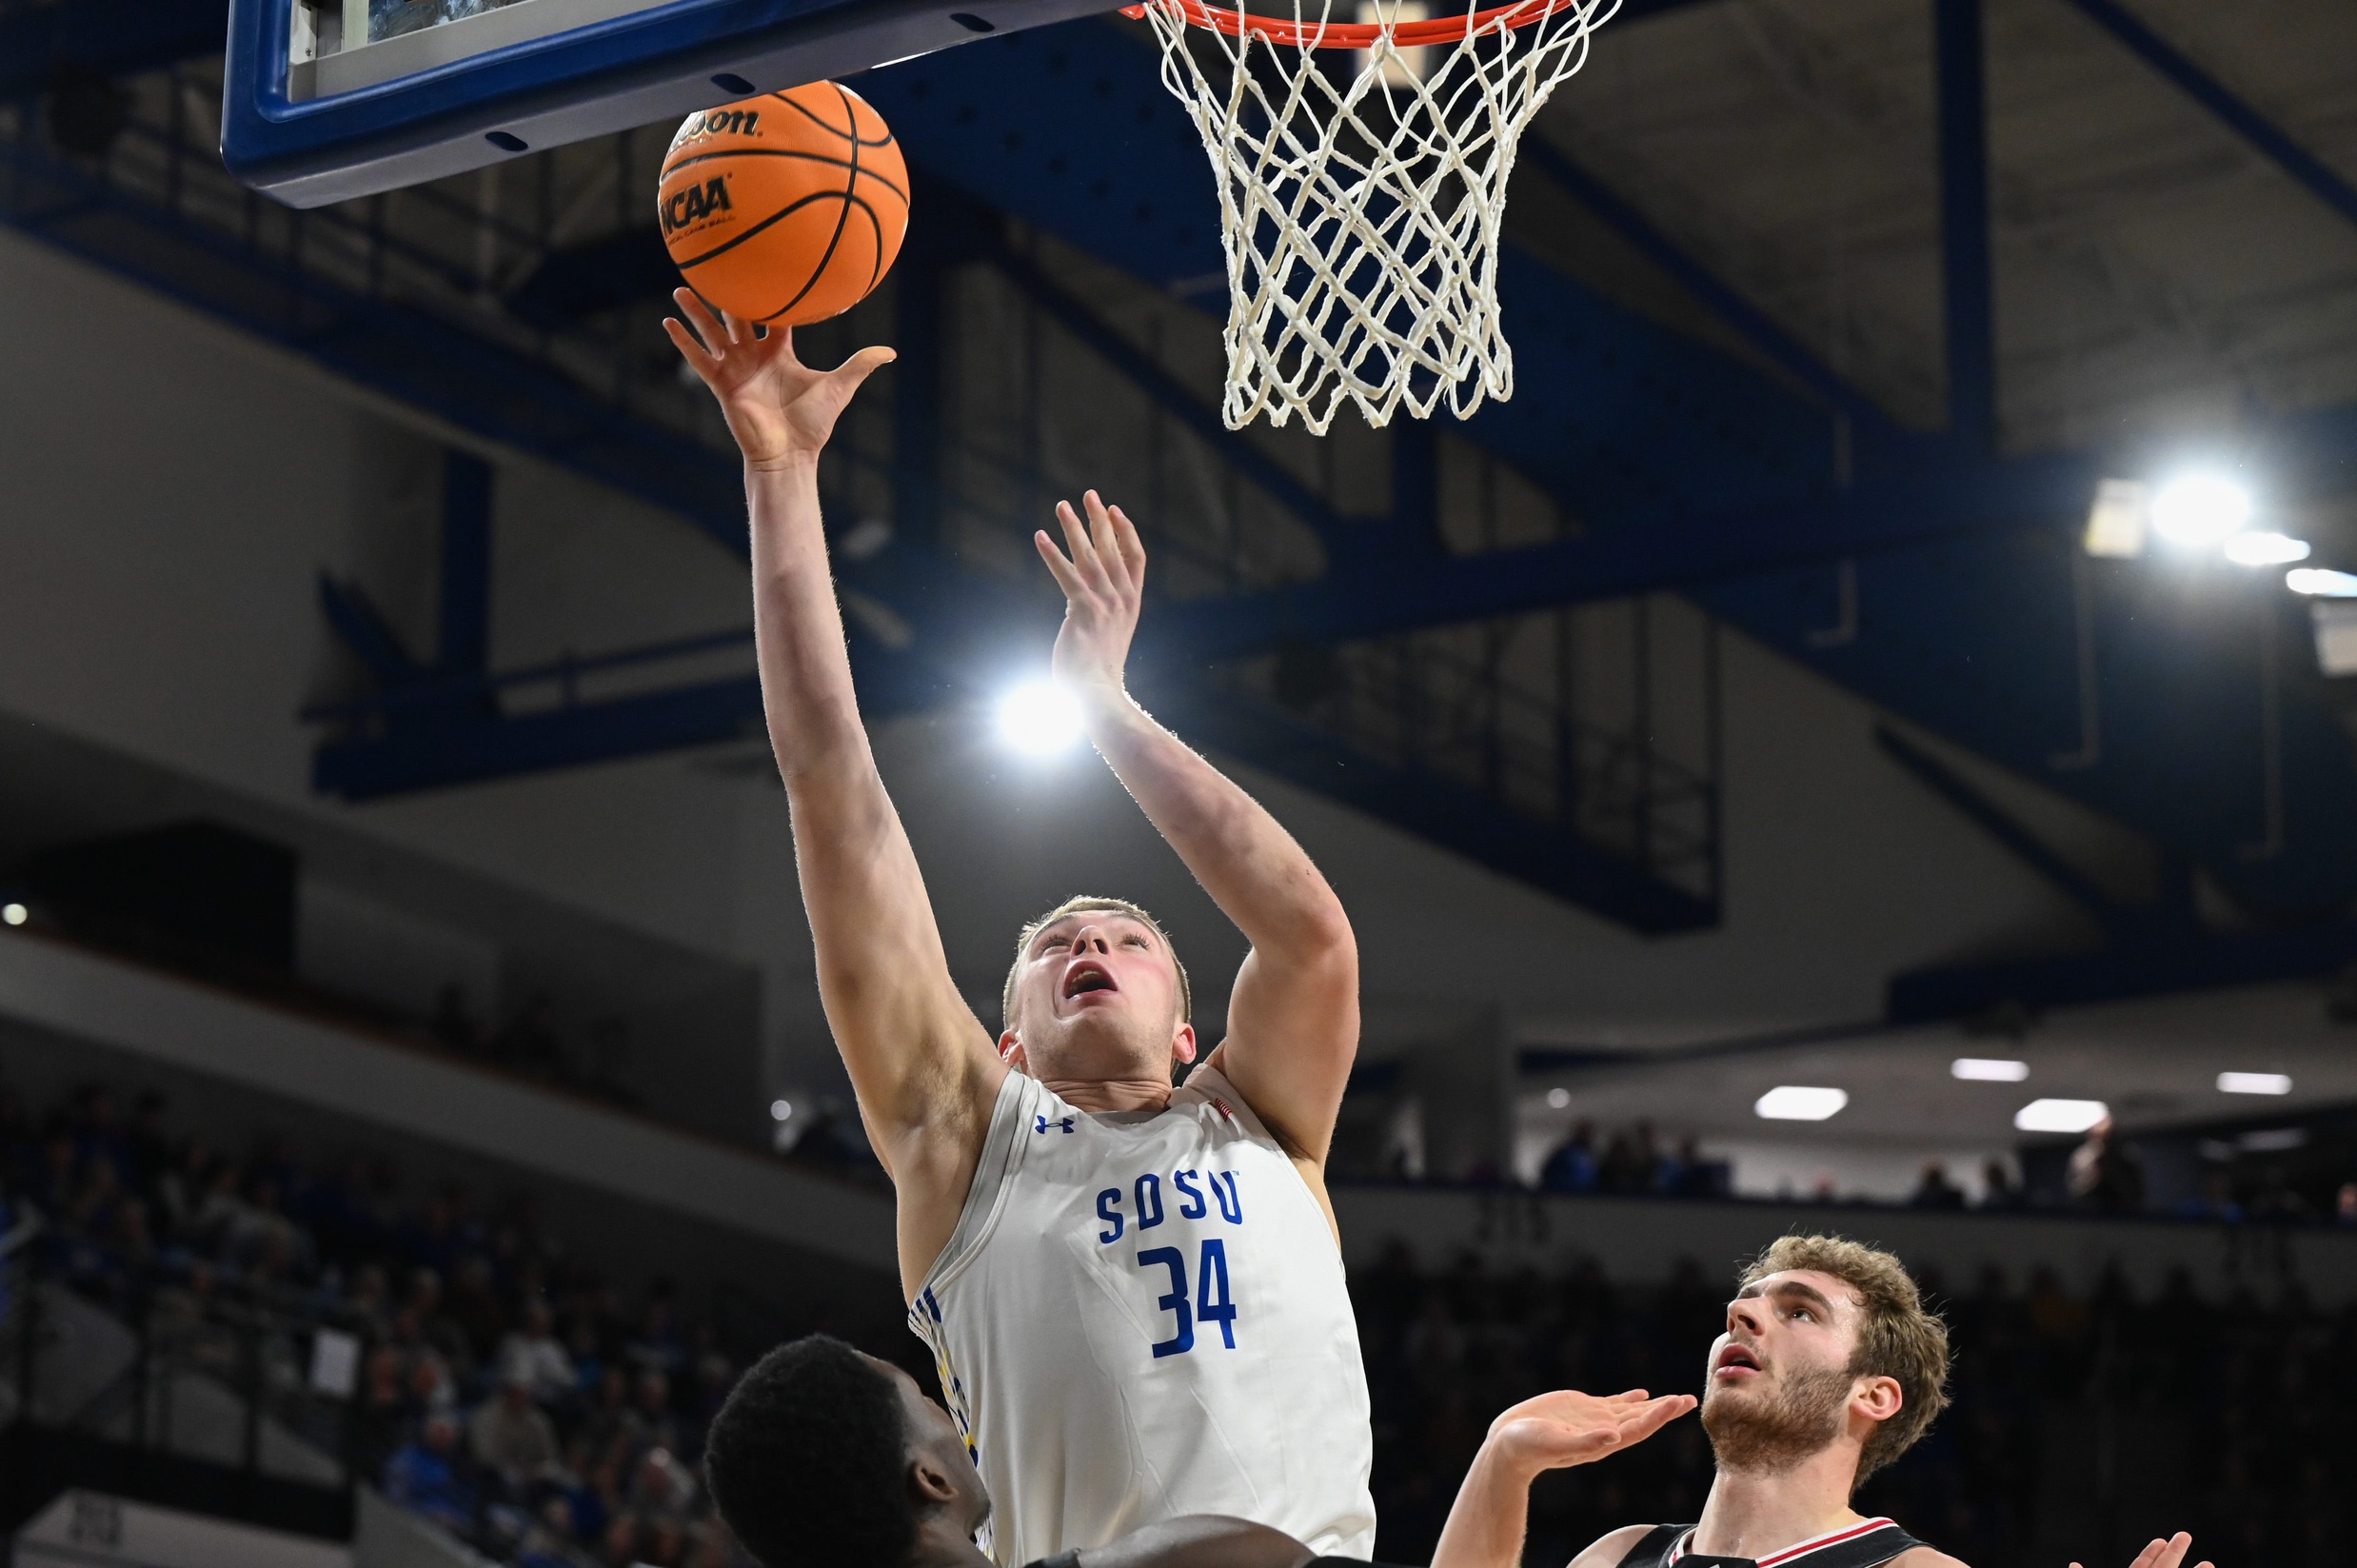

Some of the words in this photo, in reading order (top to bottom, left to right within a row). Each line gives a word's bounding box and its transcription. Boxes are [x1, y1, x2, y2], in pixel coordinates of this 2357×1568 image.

[660, 176, 732, 239] NCAA
[1097, 1169, 1242, 1244] SDSU
[1137, 1239, 1237, 1359] 34
